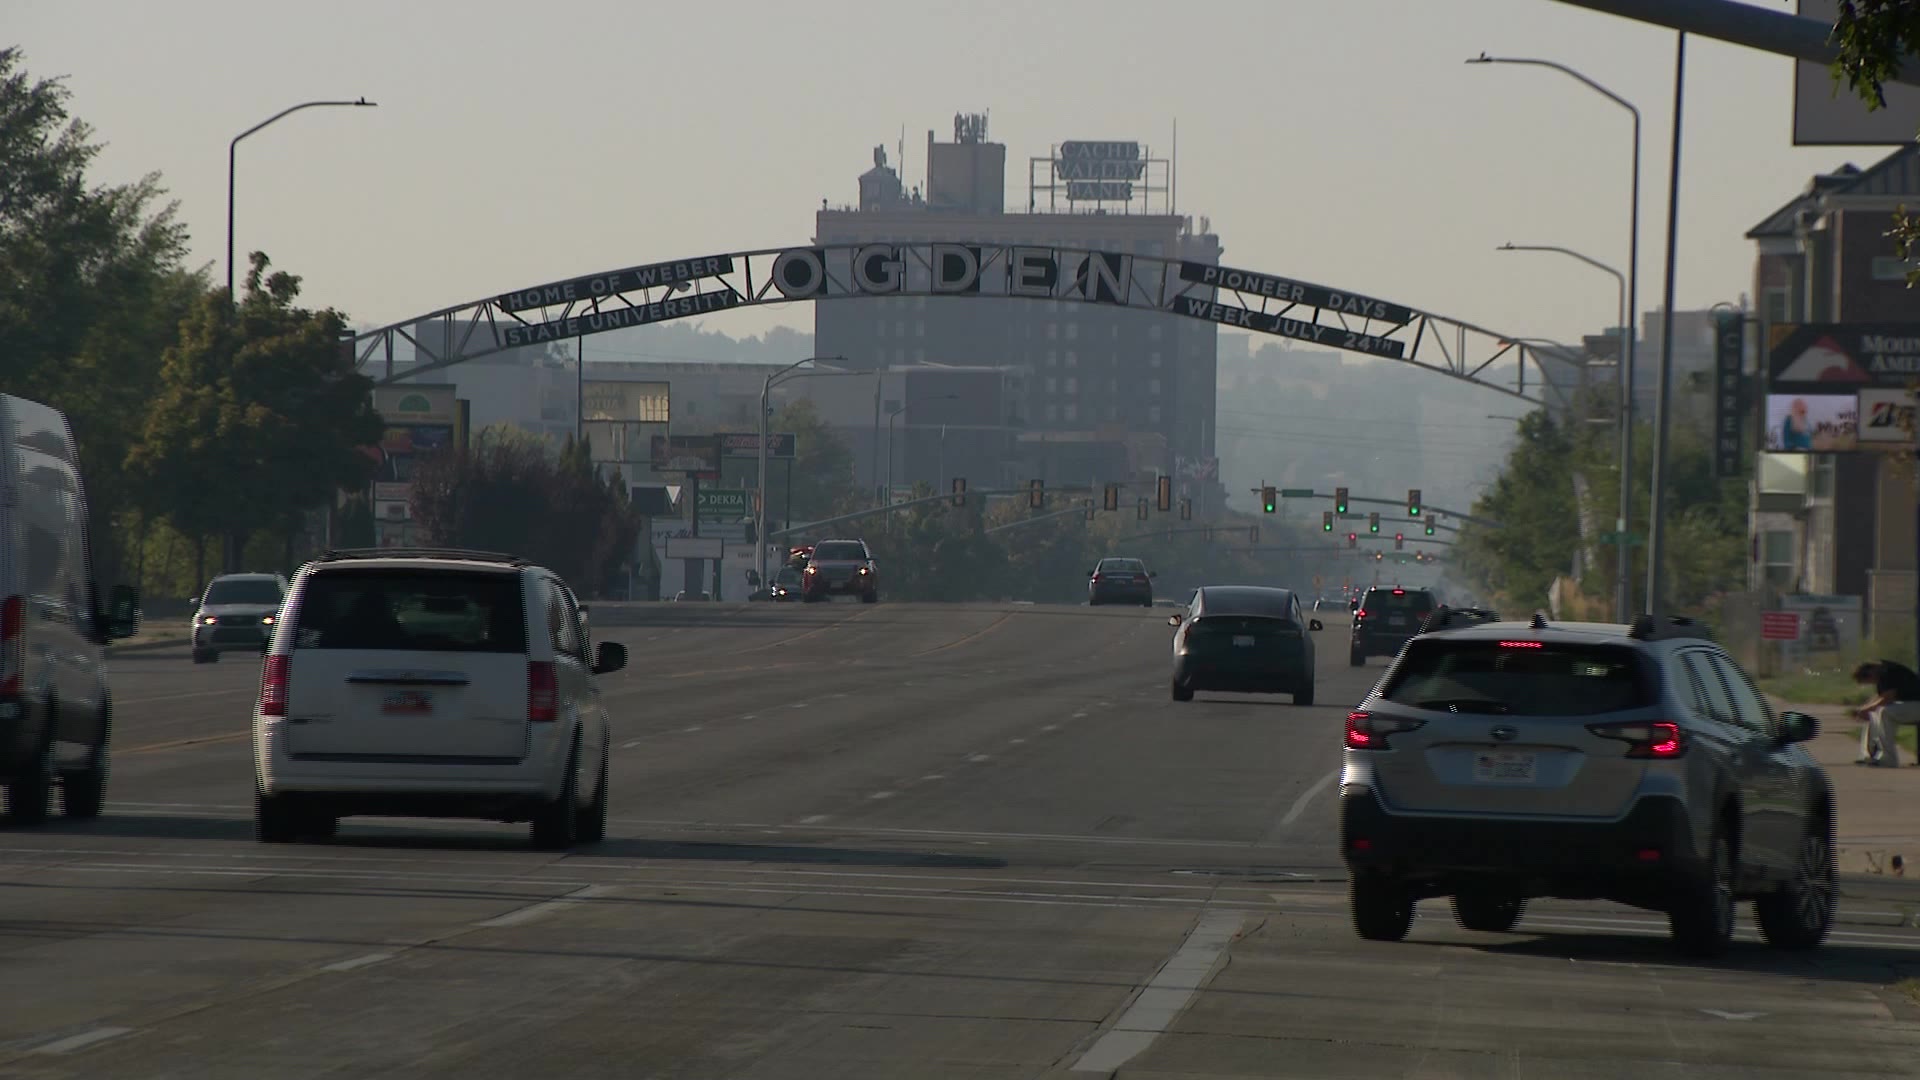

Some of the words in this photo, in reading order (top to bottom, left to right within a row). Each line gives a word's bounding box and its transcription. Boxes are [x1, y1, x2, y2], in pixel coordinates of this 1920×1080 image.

[1056, 161, 1144, 178] VALLEY
[1063, 143, 1138, 158] CACHE
[1069, 183, 1130, 199] BANK
[509, 283, 577, 309] HOME
[590, 275, 622, 294] OF
[636, 257, 721, 287] WEBER
[773, 243, 1132, 304] OGDEN
[1203, 267, 1305, 302] PIONEER
[1328, 293, 1388, 319] DAYS
[509, 319, 581, 345] STATE
[589, 290, 732, 331] UNIVERSITY
[1187, 298, 1253, 328] WEEK
[1269, 317, 1326, 341] JULY
[709, 495, 744, 505] DEKRA
